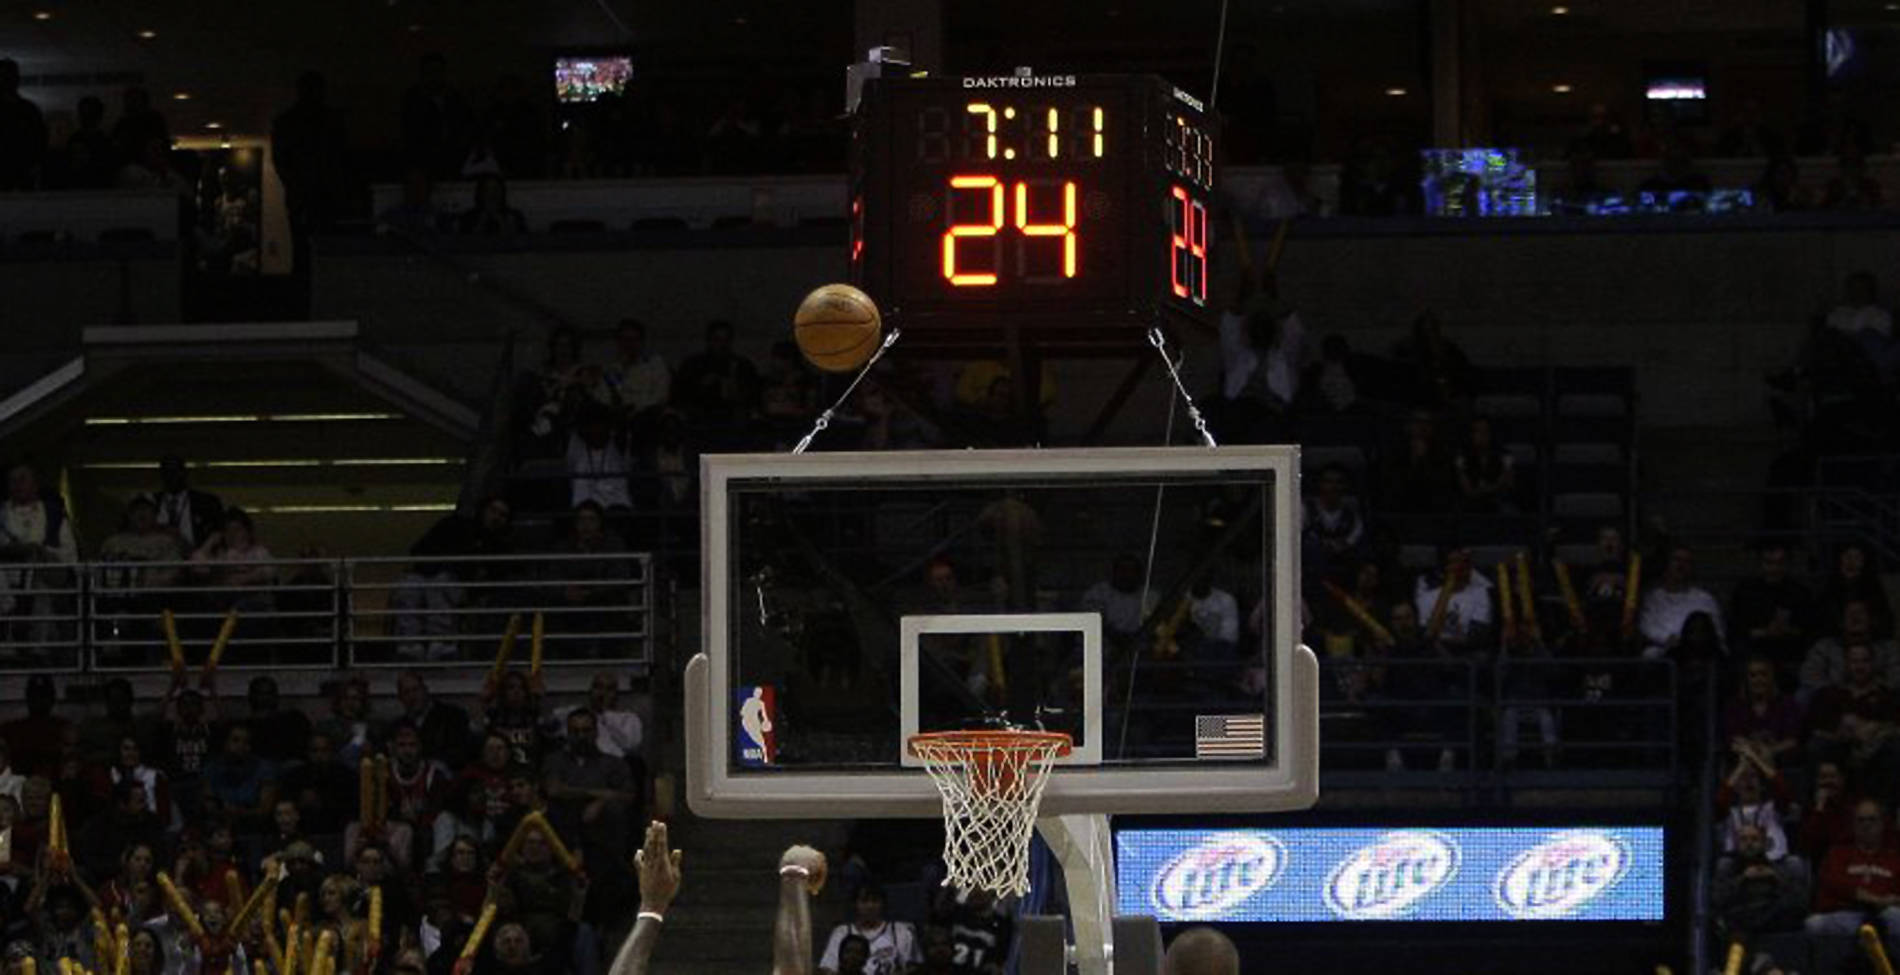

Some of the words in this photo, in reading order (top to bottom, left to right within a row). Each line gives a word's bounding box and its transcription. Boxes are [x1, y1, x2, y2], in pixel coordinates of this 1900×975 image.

[962, 76, 1076, 88] DAKTRONICS
[967, 104, 1103, 159] 7:11
[943, 176, 1076, 286] 24
[1172, 187, 1206, 301] 24
[953, 943, 985, 969] 21
